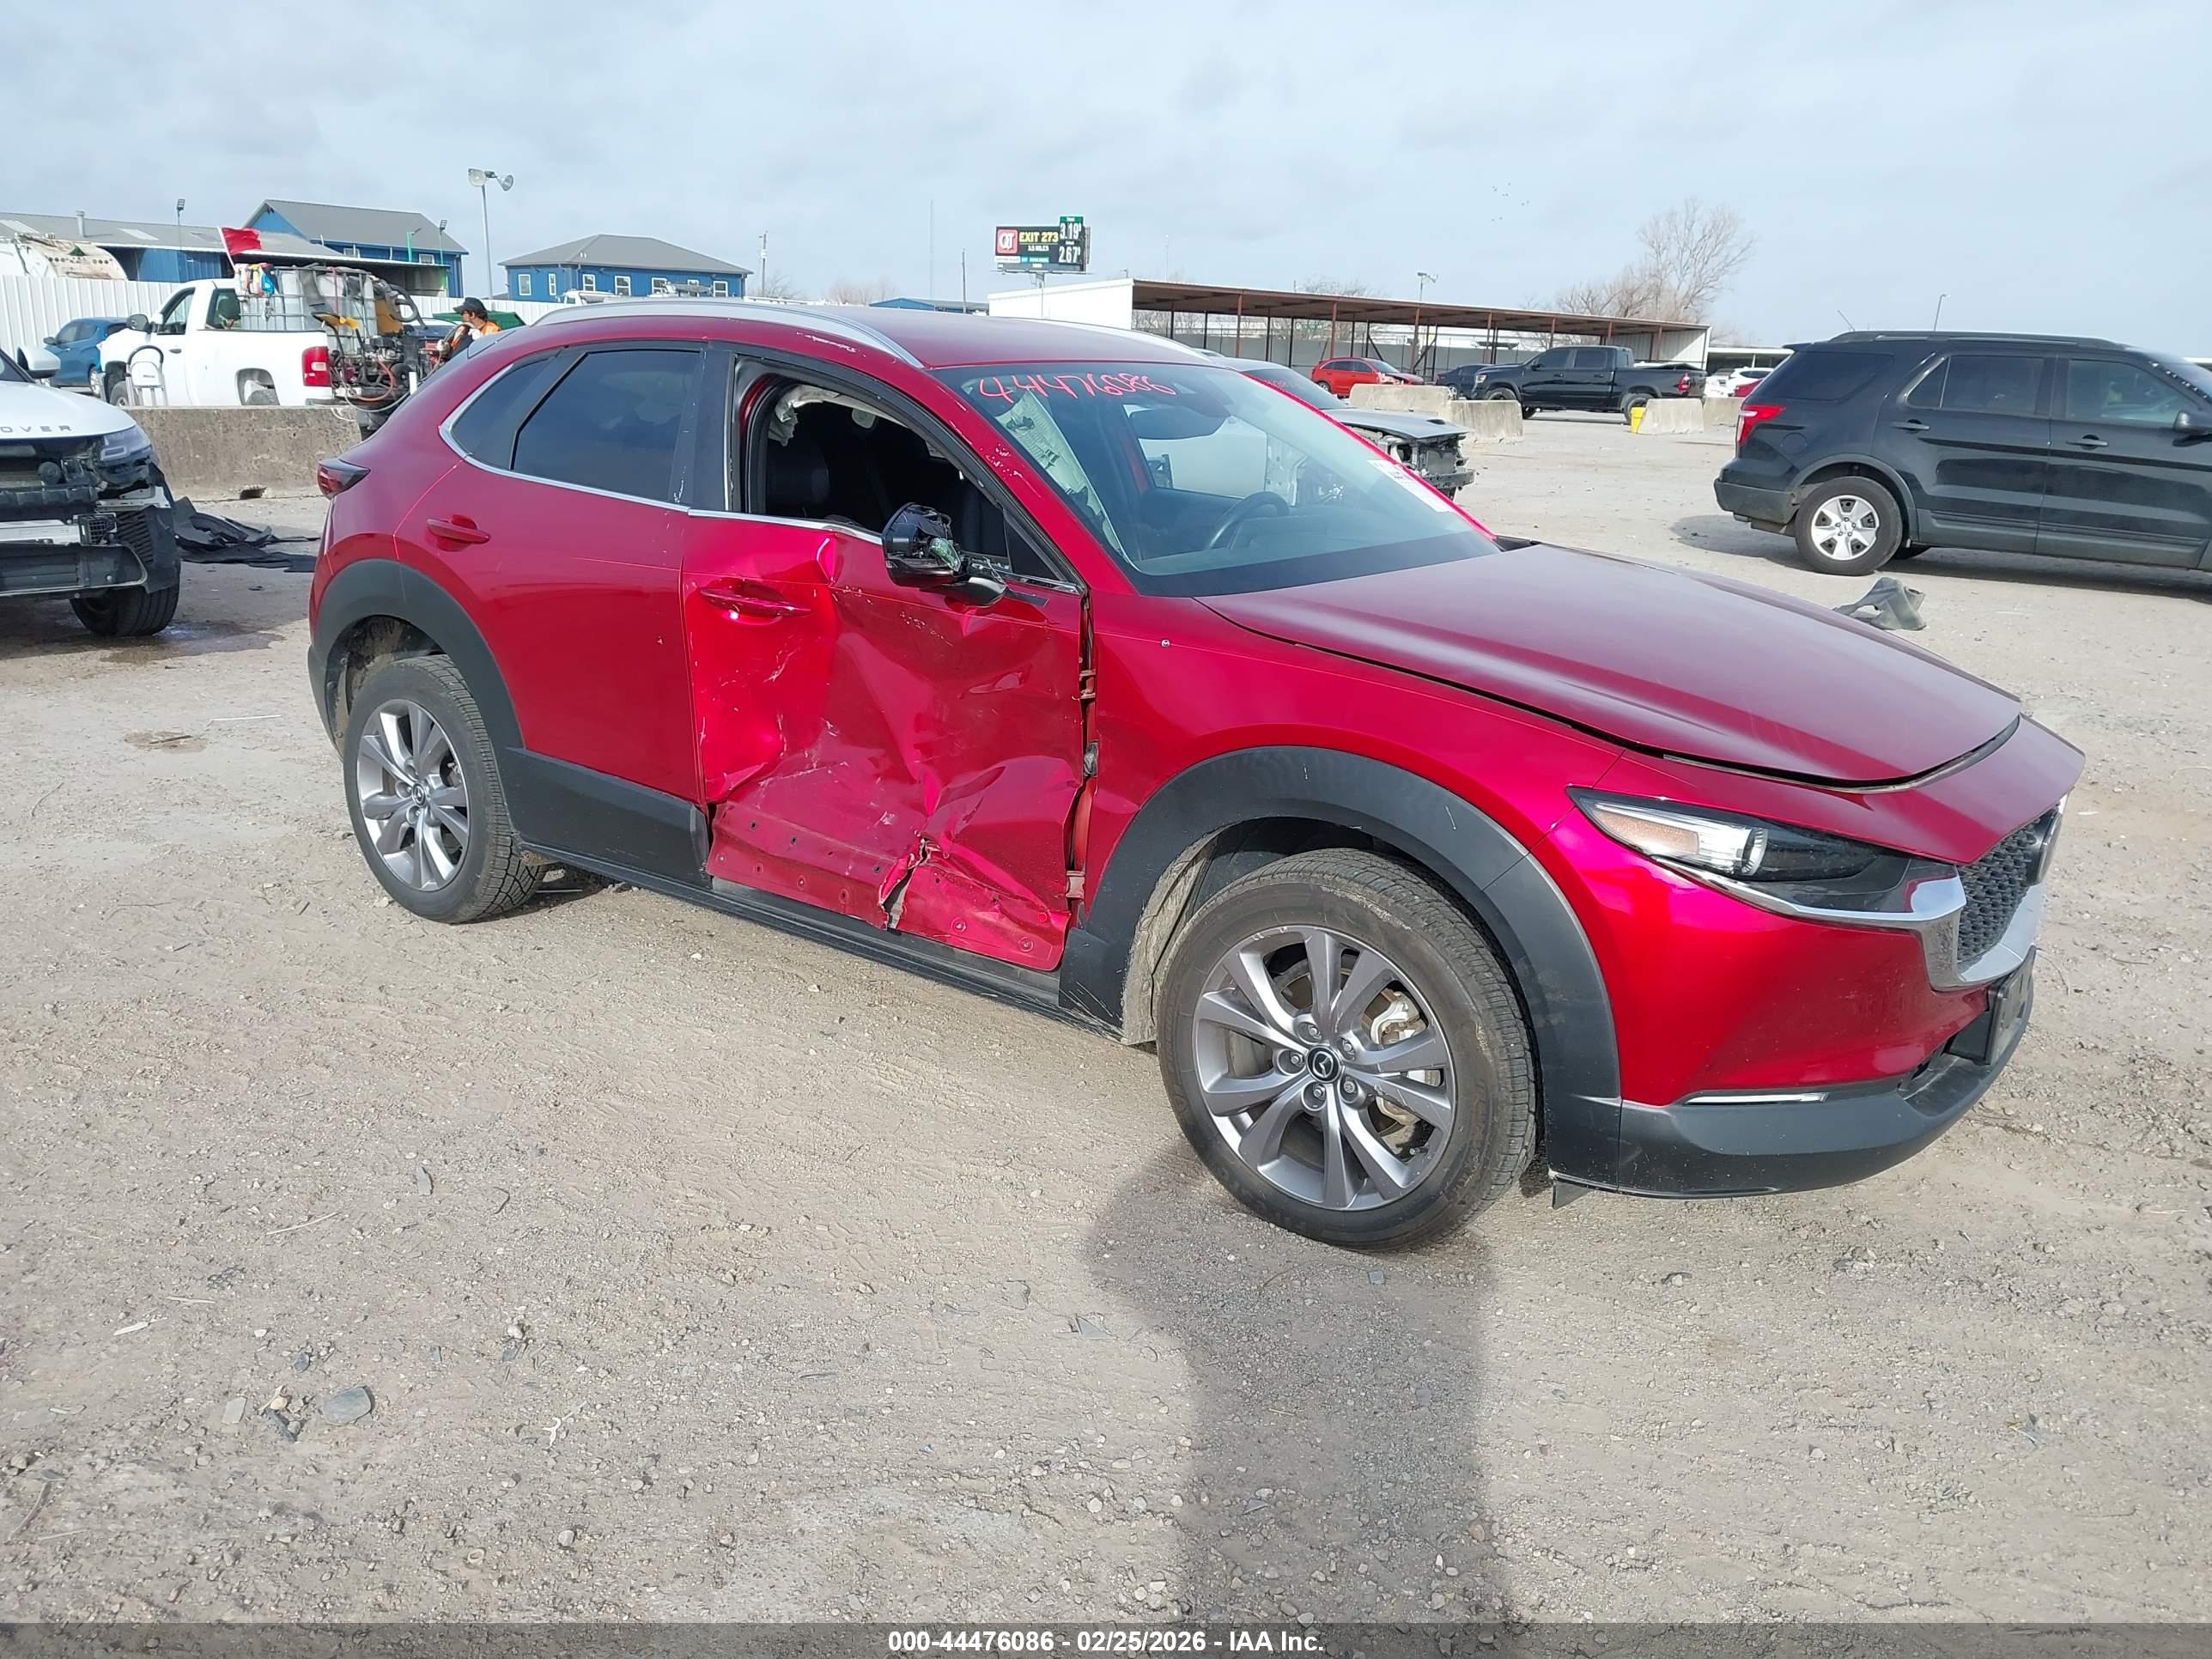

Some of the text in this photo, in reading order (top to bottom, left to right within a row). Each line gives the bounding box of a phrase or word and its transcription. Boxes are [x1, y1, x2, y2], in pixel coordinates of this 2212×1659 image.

[999, 233, 1014, 249] QT
[1019, 232, 1059, 242] EXIT 273
